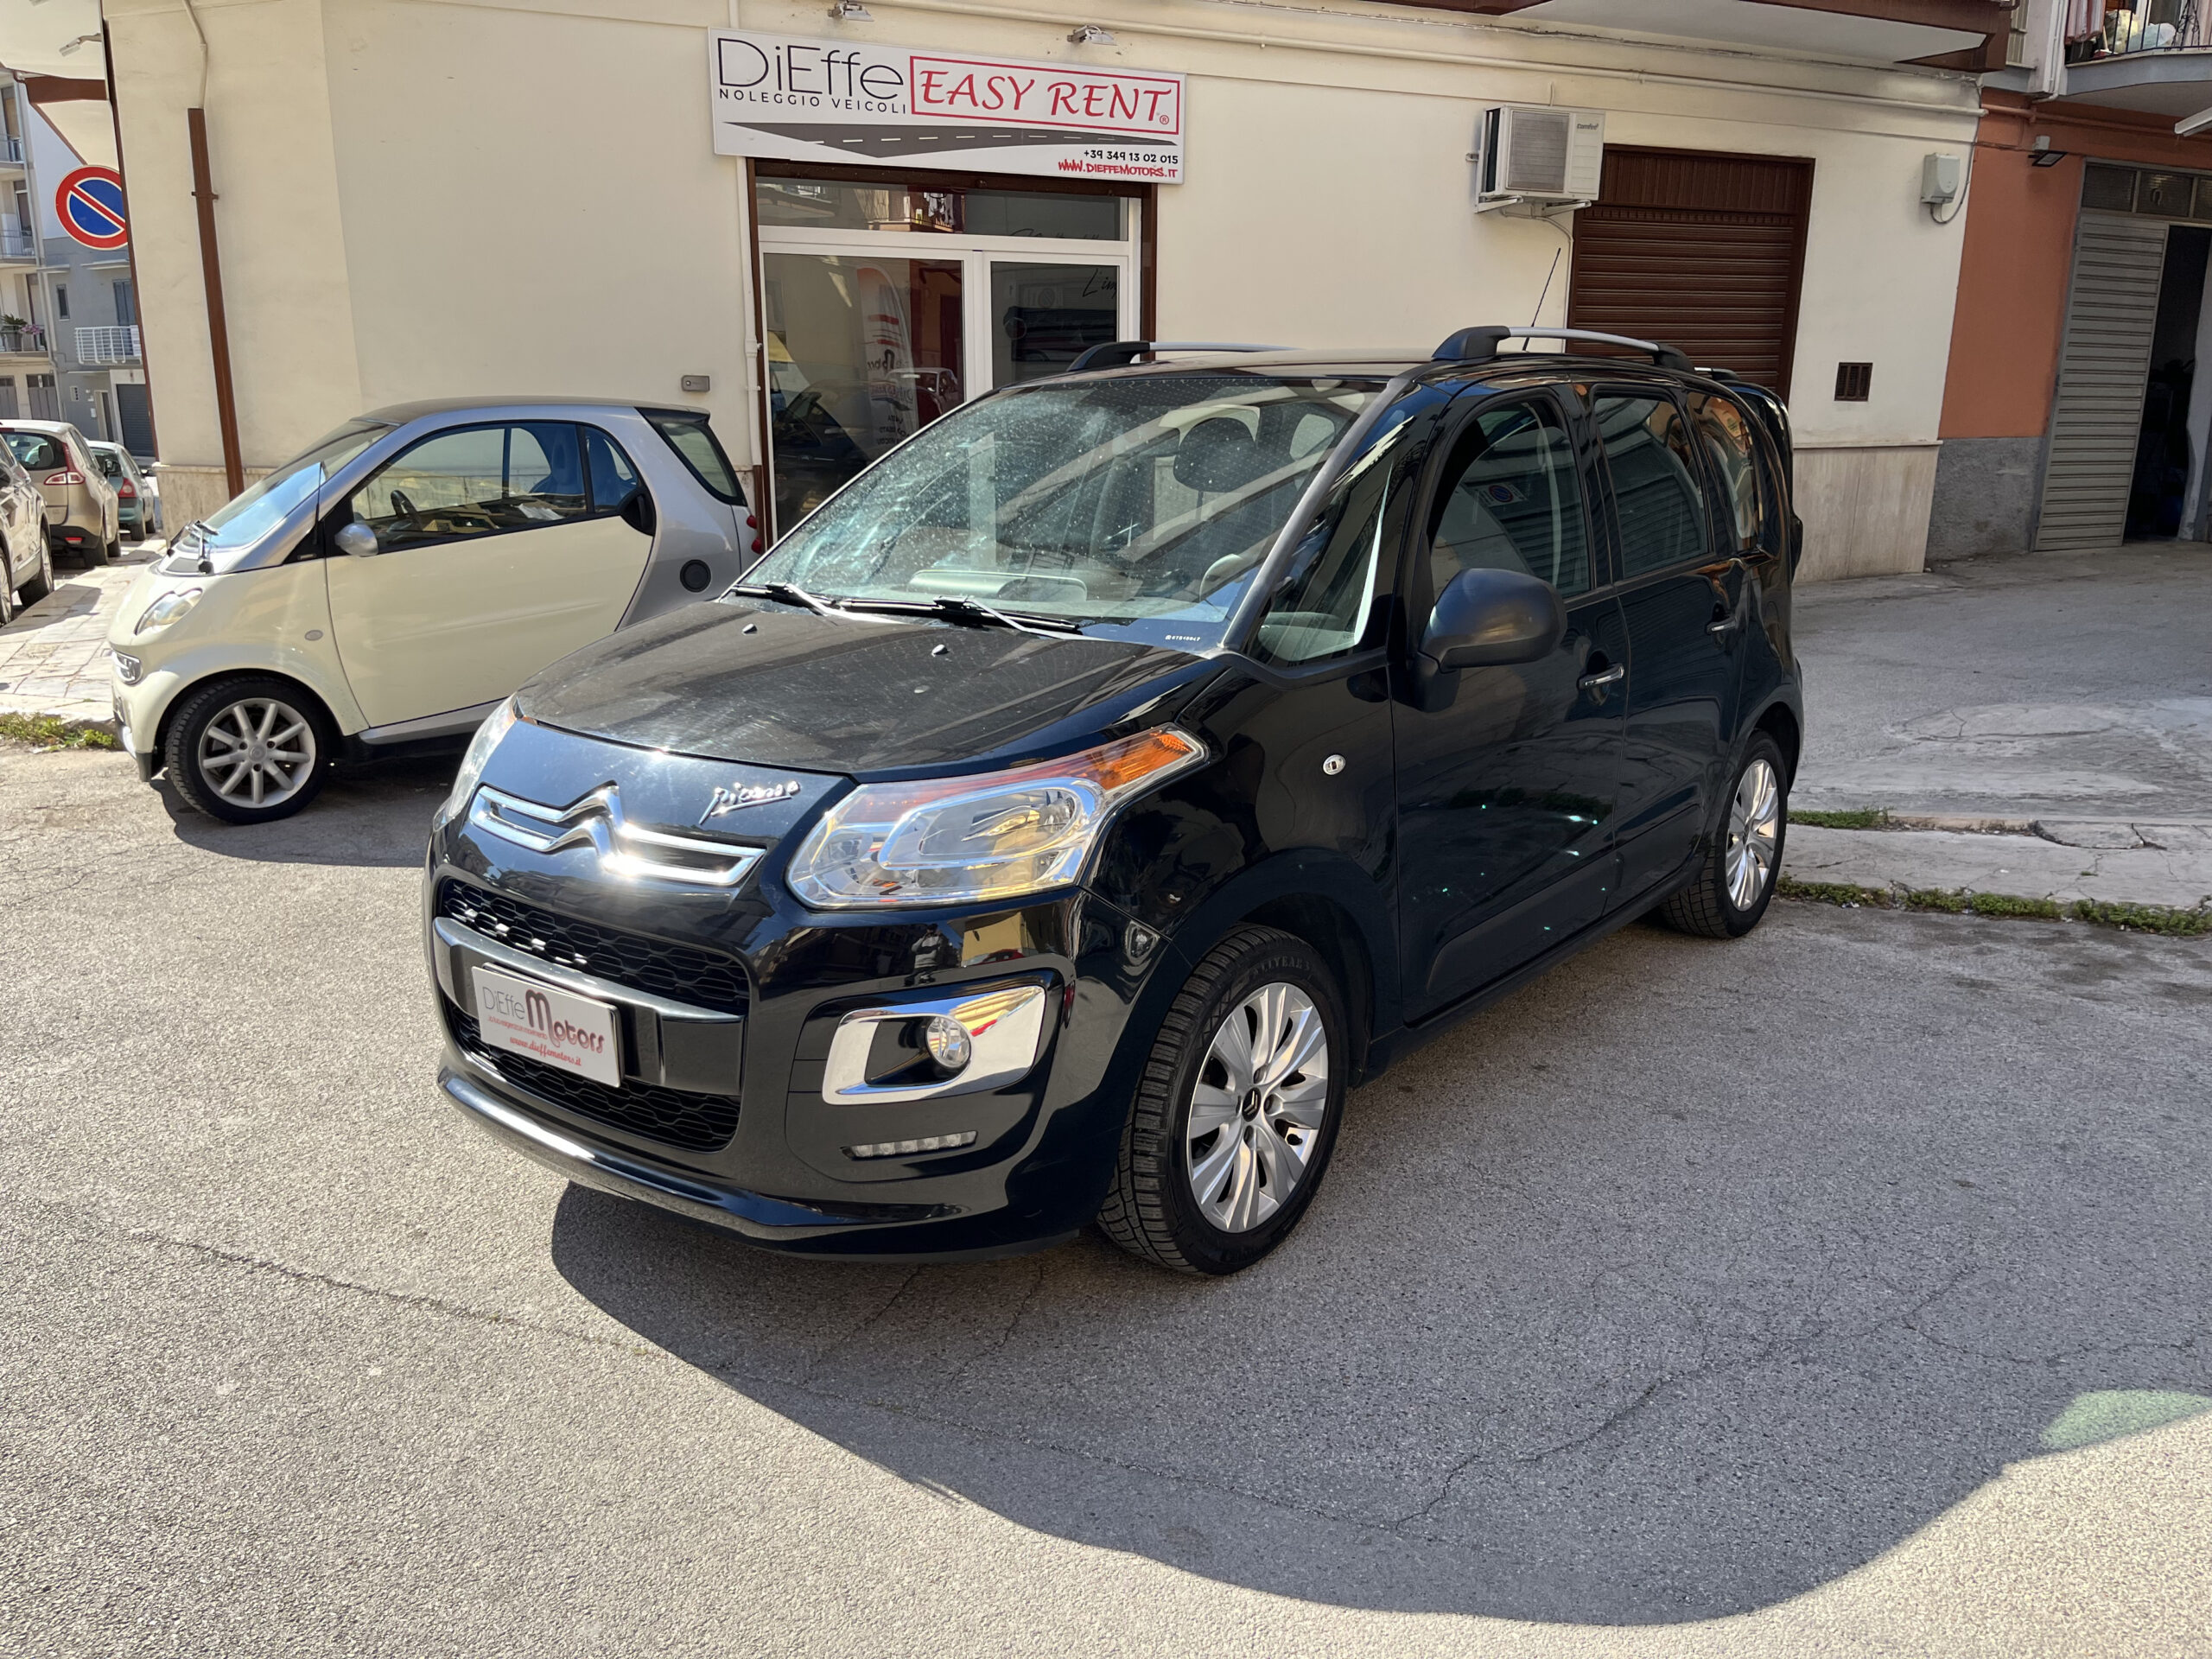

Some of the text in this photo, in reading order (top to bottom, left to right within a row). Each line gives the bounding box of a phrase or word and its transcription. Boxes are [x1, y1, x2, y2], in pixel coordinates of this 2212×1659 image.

[717, 37, 904, 99] DiEffe
[719, 88, 906, 114] NOLEGGIO VEICOLI
[919, 70, 1035, 111] EASY
[1047, 82, 1172, 121] RENT
[1084, 149, 1179, 164] +39 349 13 02 015
[482, 986, 525, 1020] DiEffe
